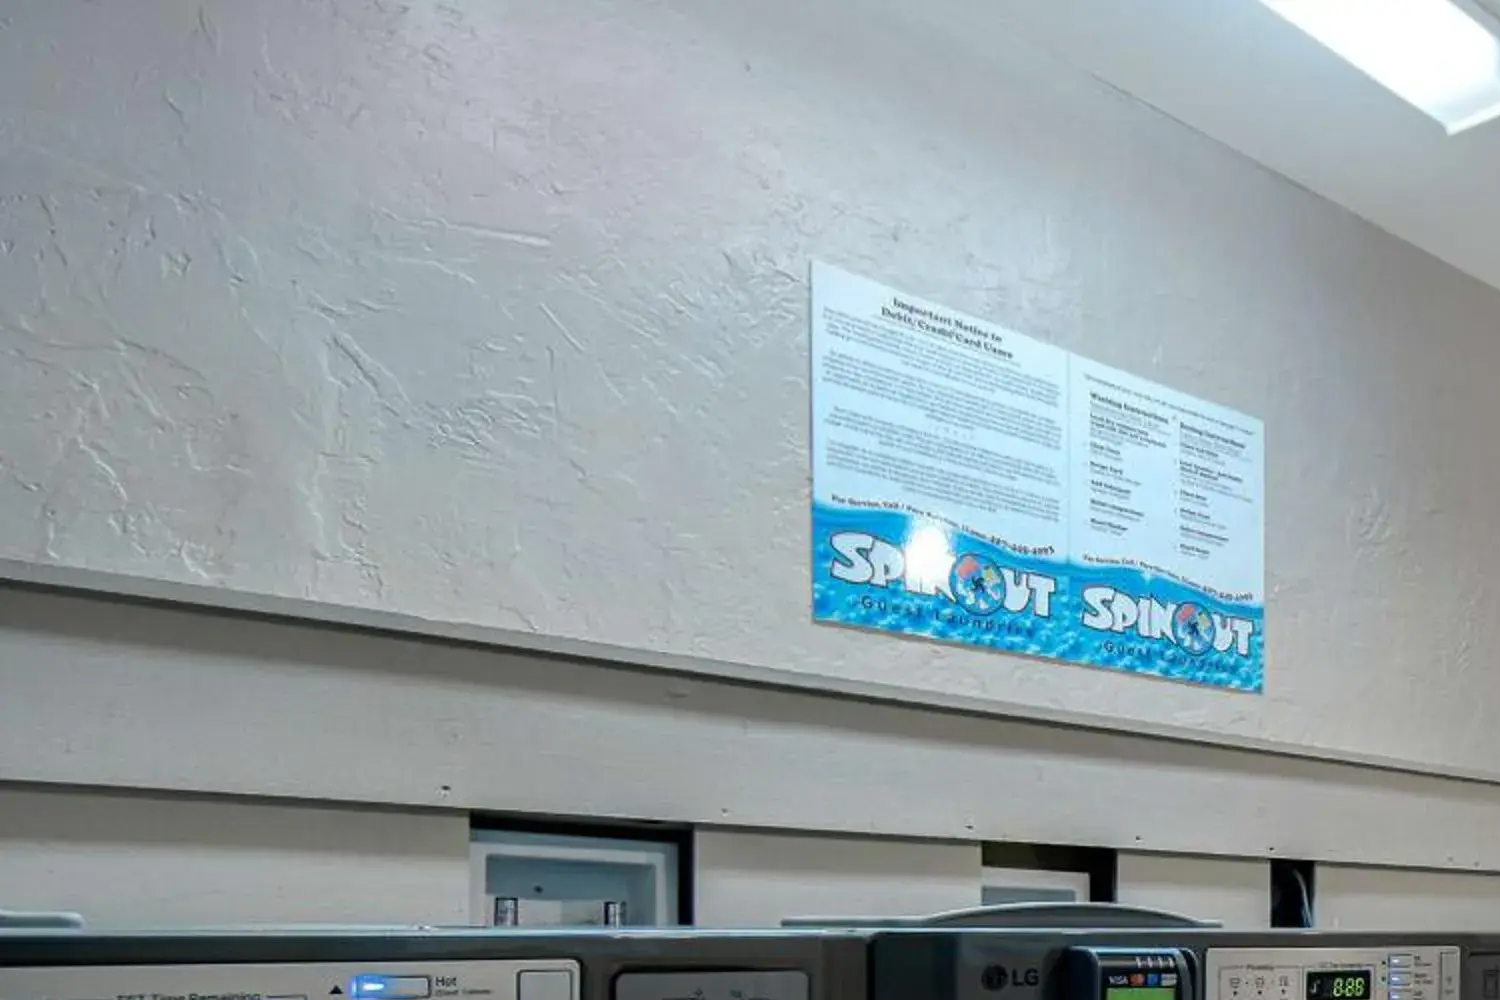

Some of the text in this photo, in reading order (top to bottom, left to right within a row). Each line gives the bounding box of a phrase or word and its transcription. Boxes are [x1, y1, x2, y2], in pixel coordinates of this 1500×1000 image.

[893, 297, 1003, 341] Important Notice to
[955, 333, 981, 348] Card
[983, 342, 1013, 359] Users
[1082, 584, 1254, 658] SPINOUT
[435, 976, 457, 986] Hot
[1012, 968, 1039, 987] LG
